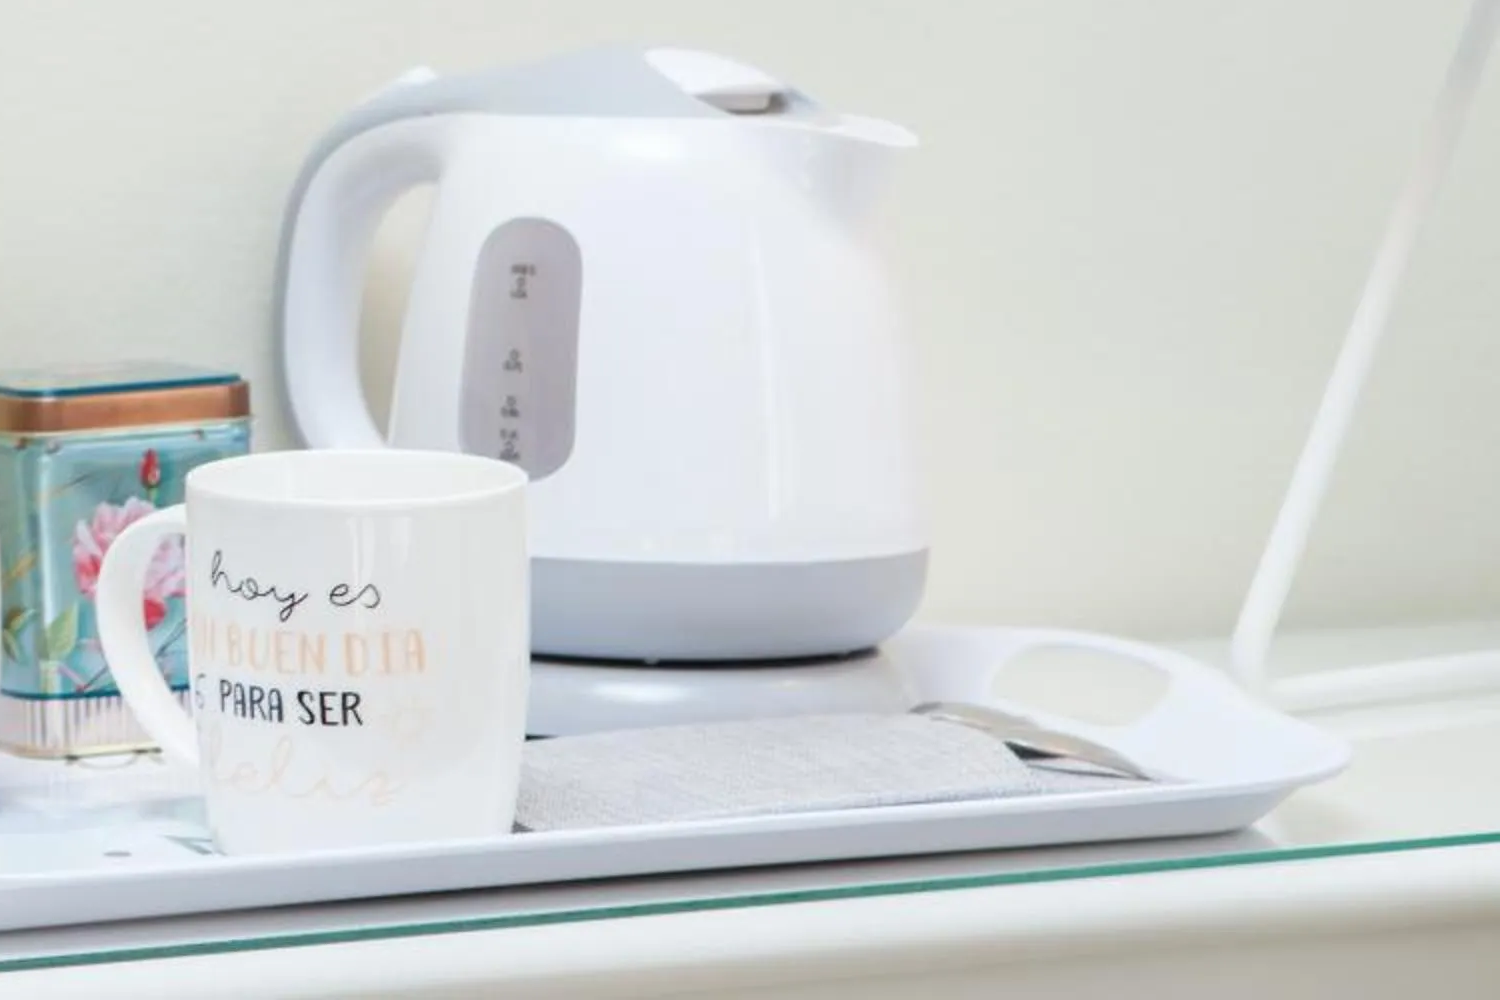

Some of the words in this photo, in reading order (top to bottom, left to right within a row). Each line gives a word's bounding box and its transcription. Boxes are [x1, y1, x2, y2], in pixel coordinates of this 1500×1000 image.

[209, 549, 309, 622] hoy
[329, 582, 382, 609] es
[226, 621, 329, 676] BUEN
[219, 678, 285, 724] PARA
[296, 690, 365, 727] SER
